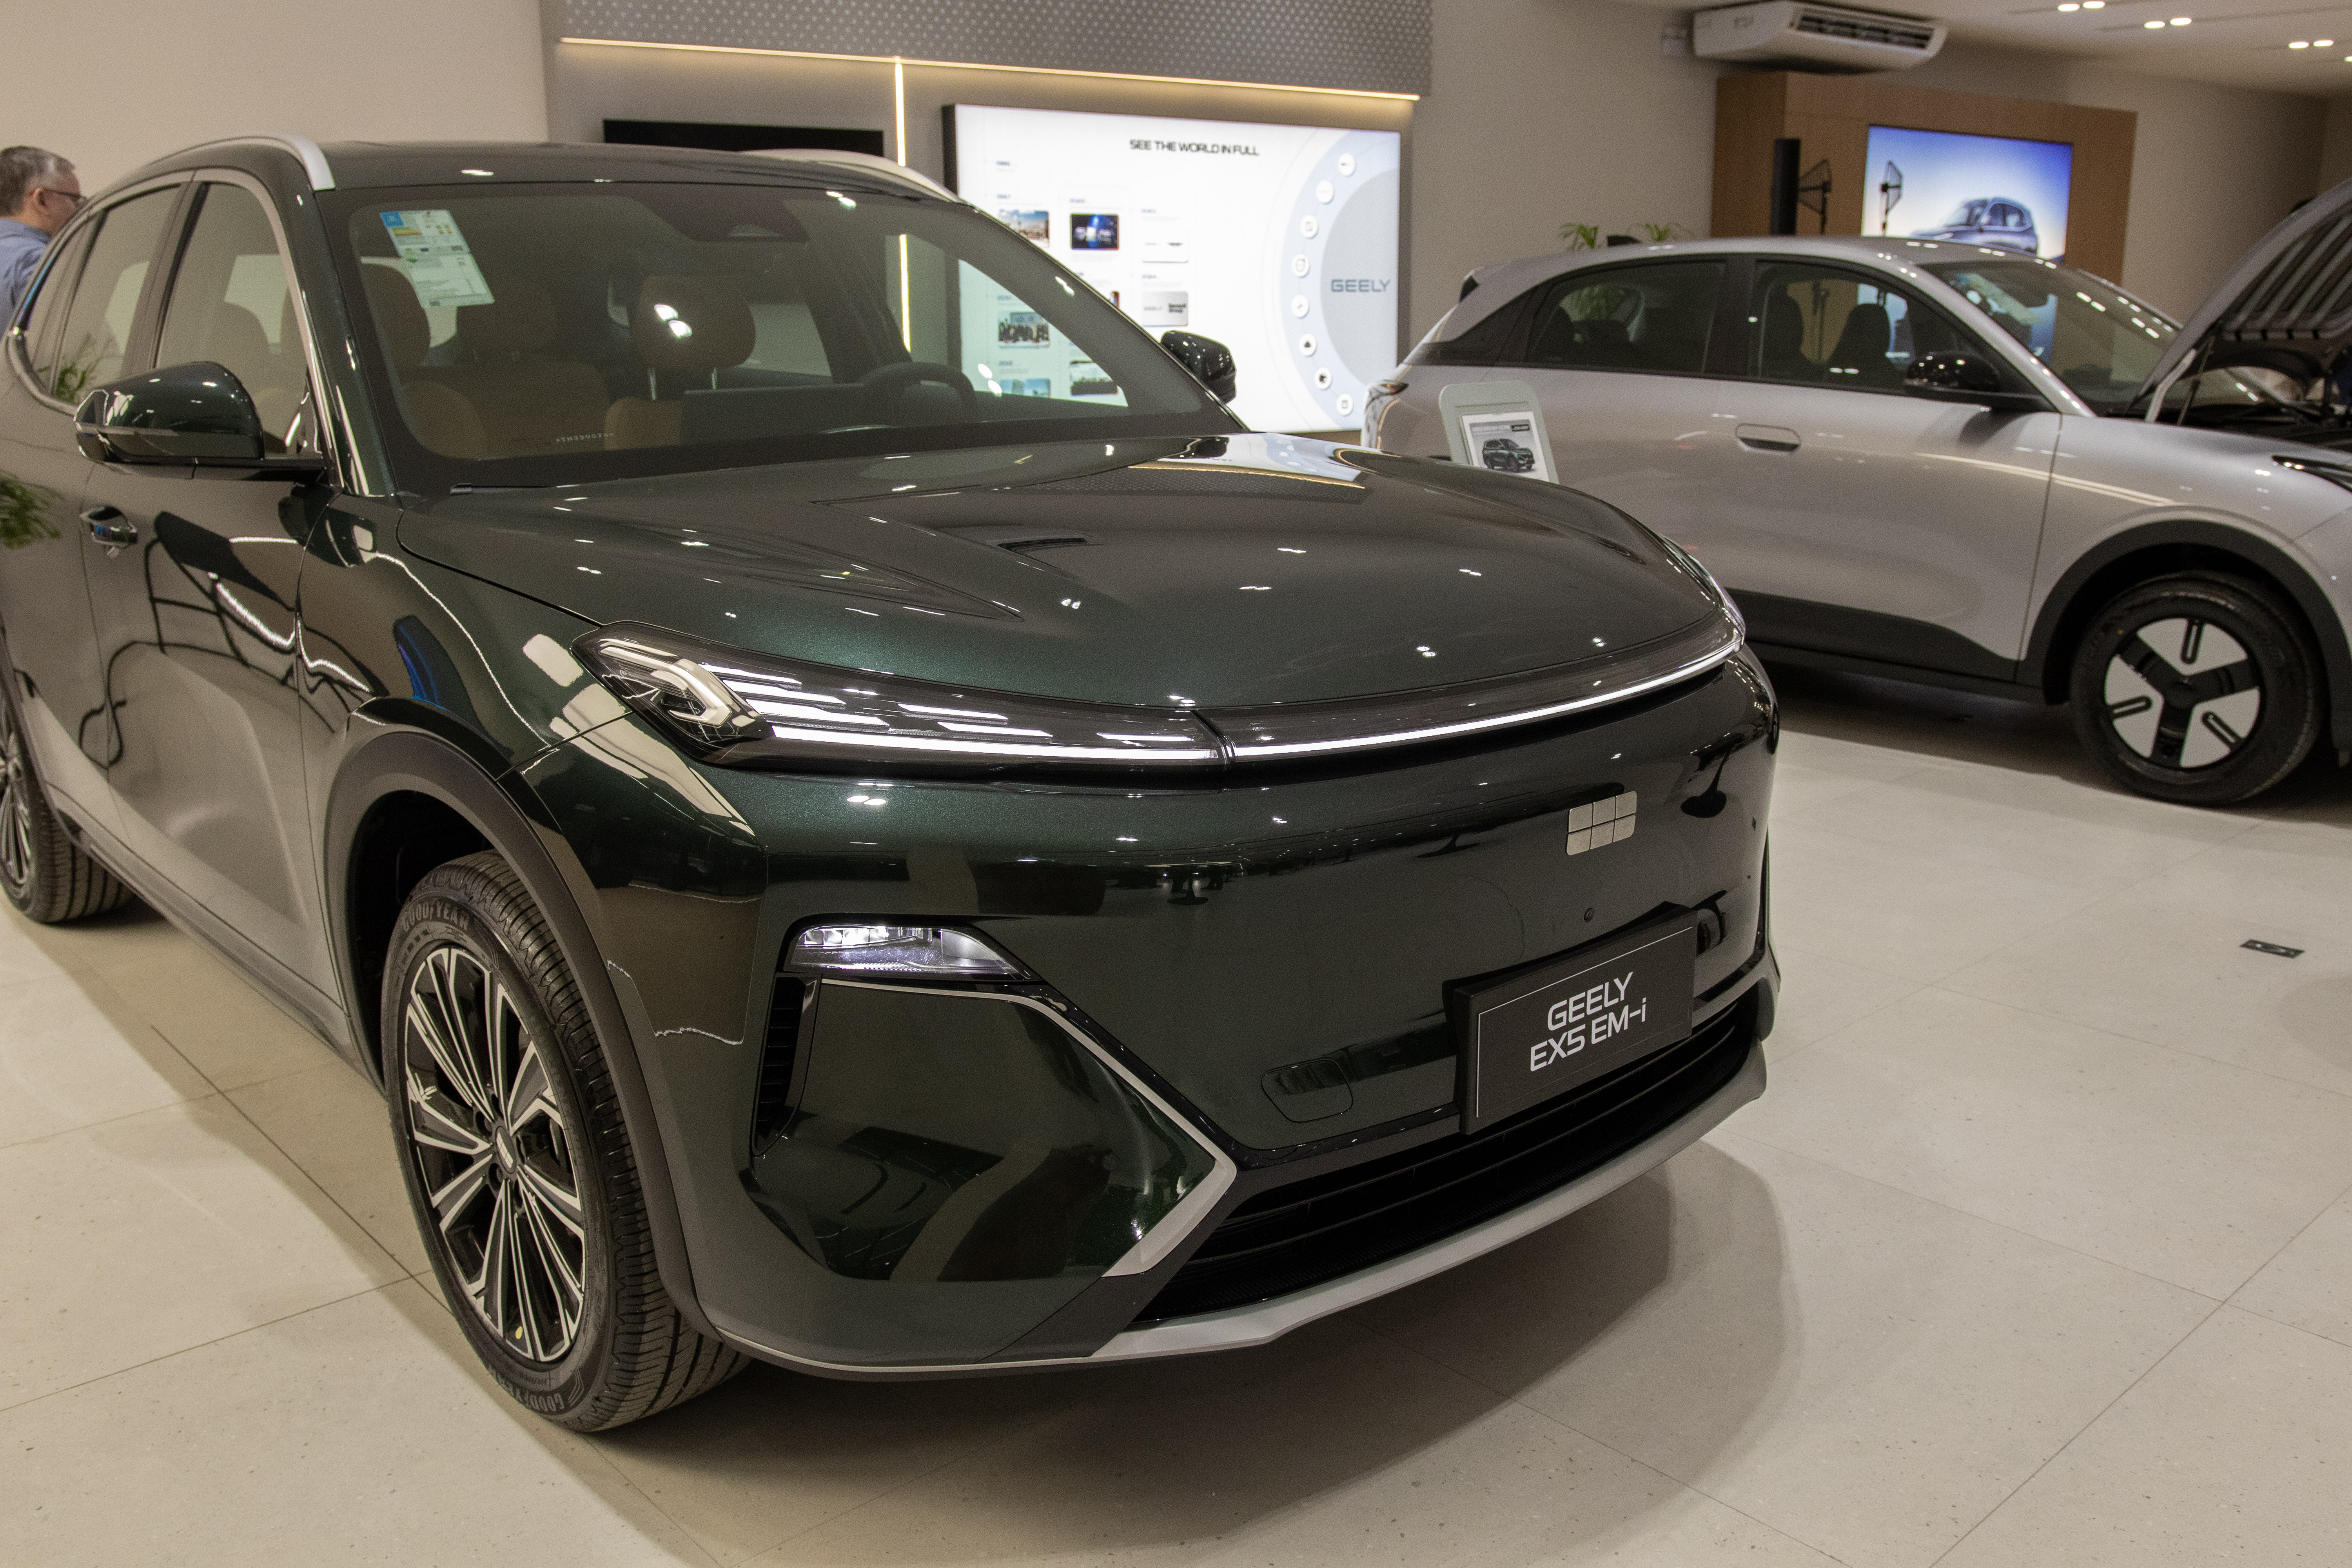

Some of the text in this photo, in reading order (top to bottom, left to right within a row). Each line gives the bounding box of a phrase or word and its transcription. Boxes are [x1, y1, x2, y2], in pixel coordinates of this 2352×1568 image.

[1129, 139, 1259, 156] SEE THE WORLD IN FULL
[1331, 279, 1391, 292] GEELY
[1548, 972, 1633, 1031] GEELY
[1530, 997, 1647, 1072] EX5 EM-i
